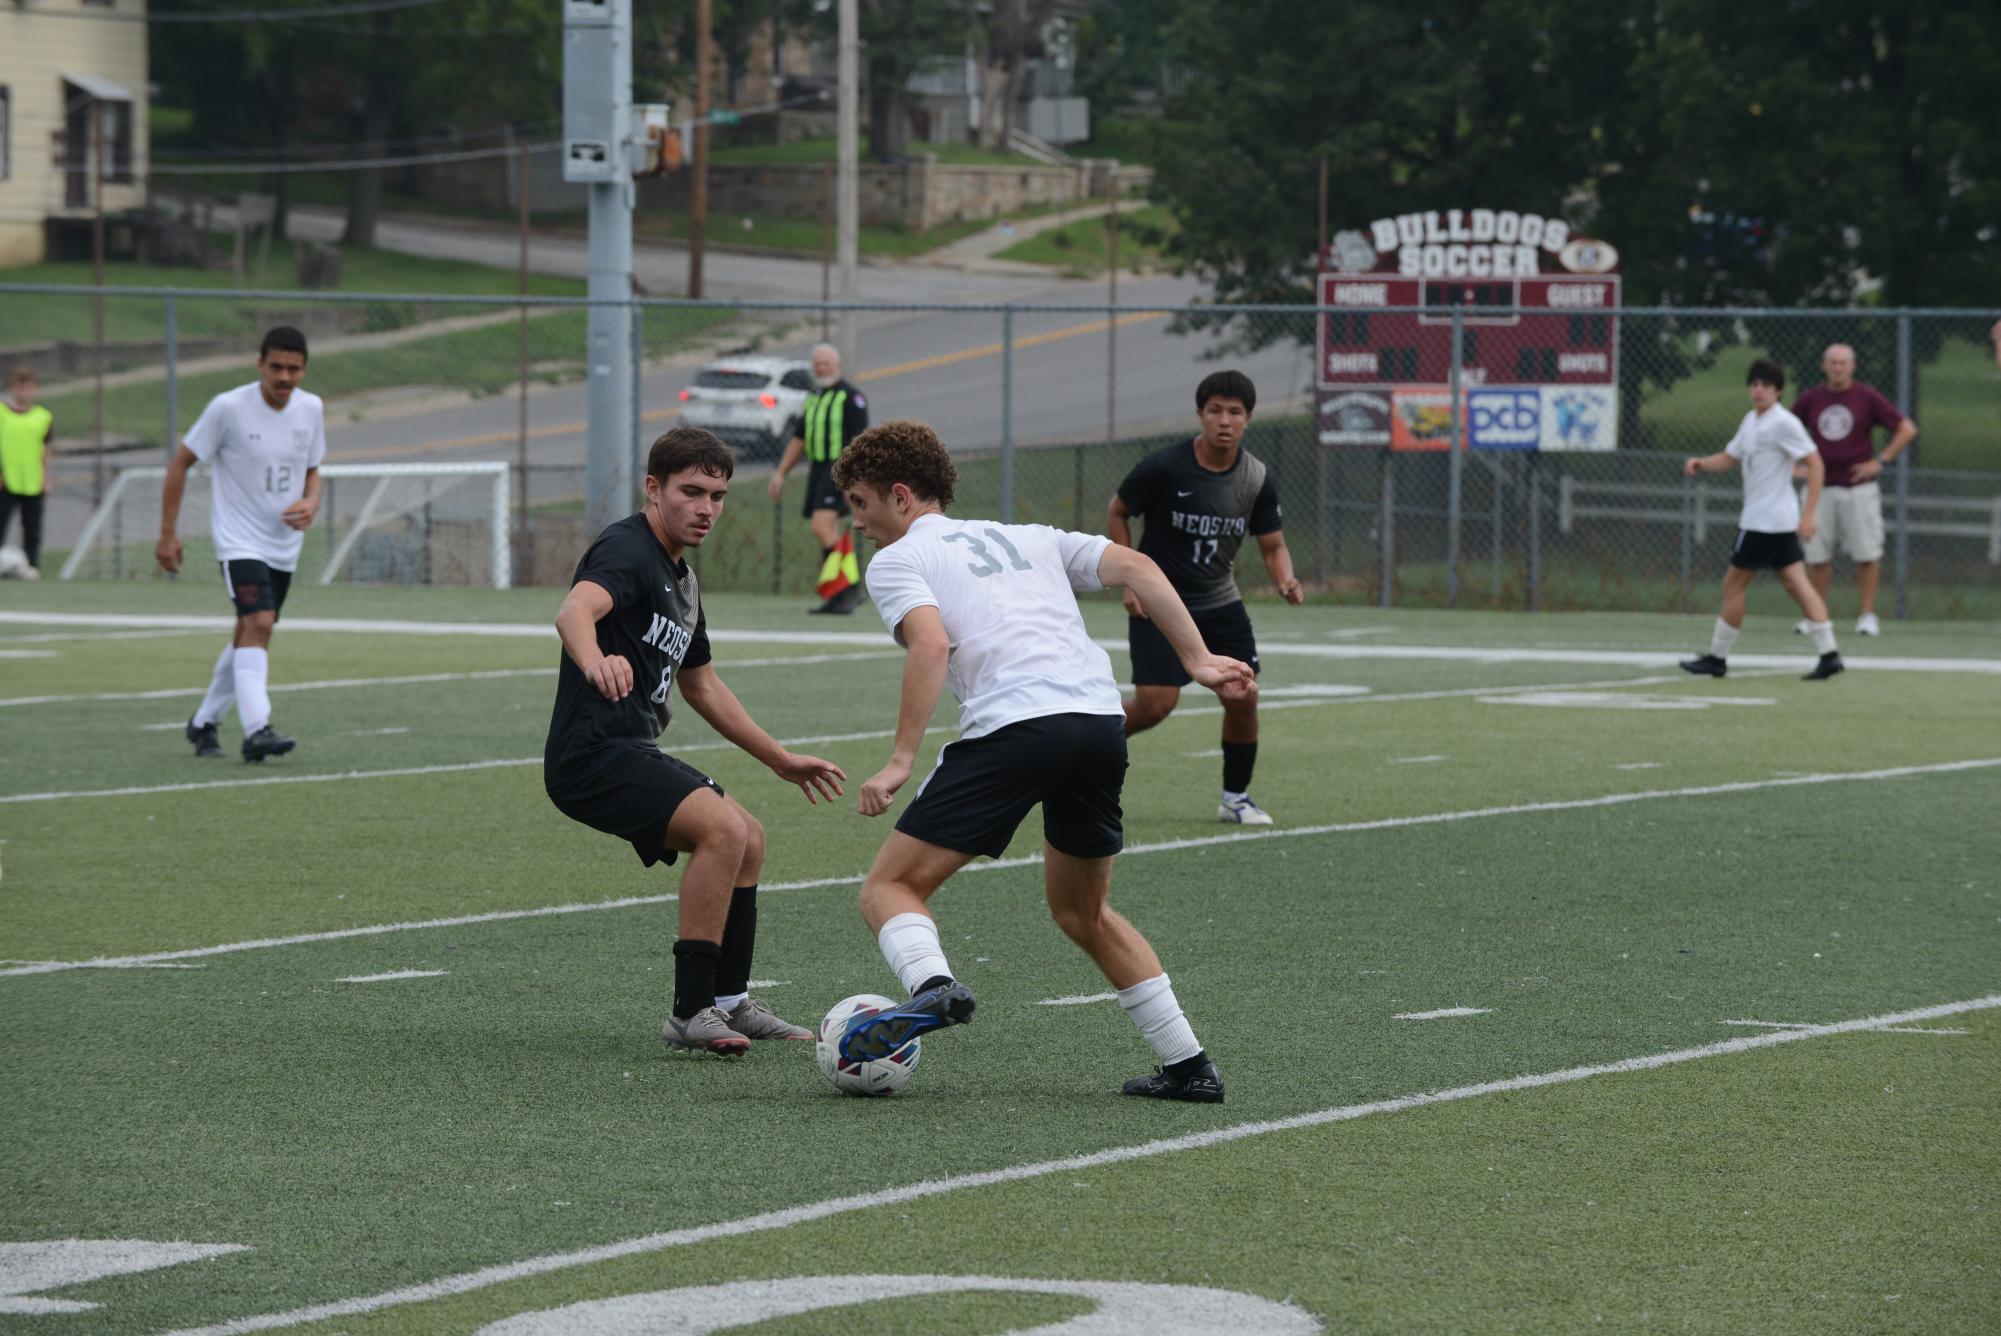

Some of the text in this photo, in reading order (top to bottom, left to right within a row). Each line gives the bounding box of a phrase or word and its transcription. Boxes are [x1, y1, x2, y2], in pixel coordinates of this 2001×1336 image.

[1370, 208, 1570, 253] BULLDOGS
[1399, 244, 1540, 278] SOCCER
[1546, 283, 1607, 307] GUEST
[265, 465, 291, 493] 12
[1171, 511, 1246, 536] NEOSHO
[941, 527, 1033, 578] 31
[1192, 539, 1219, 564] 17
[641, 611, 692, 667] NEOS
[650, 664, 671, 704] 8
